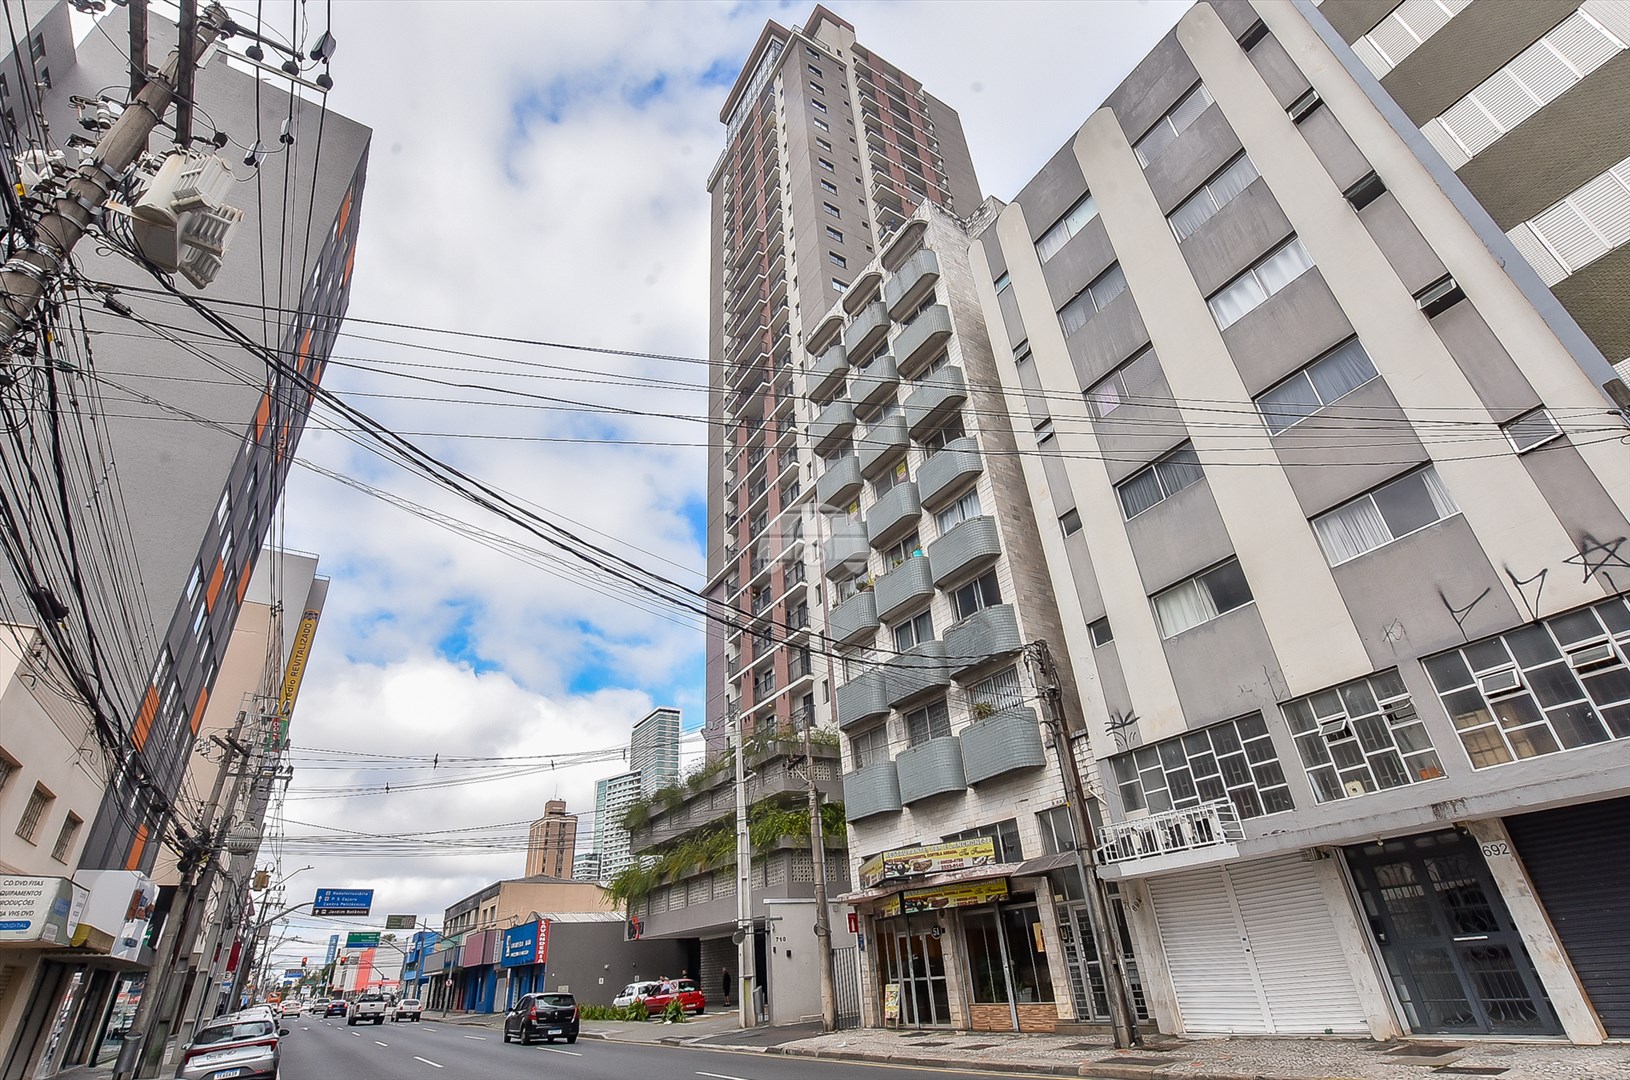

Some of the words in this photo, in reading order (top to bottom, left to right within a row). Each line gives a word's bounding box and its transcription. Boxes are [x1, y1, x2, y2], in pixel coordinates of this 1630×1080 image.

[291, 623, 312, 677] REVITALIZADO
[1482, 843, 1510, 857] 692
[538, 920, 547, 963] LAVANDERIA
